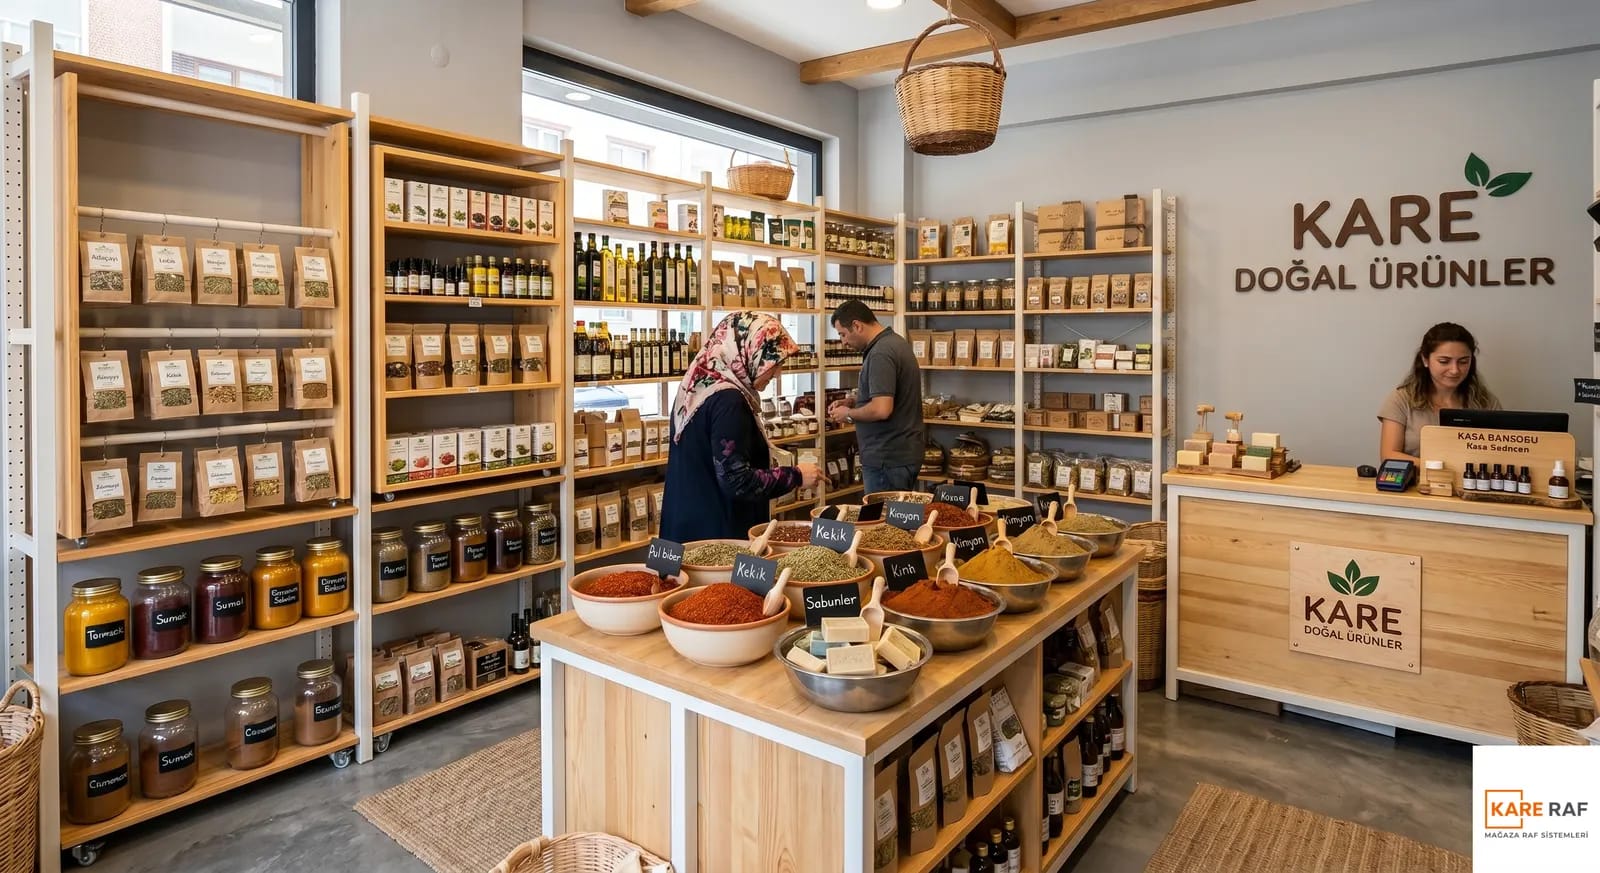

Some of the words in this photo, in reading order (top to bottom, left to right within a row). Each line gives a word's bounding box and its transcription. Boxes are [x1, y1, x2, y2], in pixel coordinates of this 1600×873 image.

[1293, 189, 1480, 251] KARE
[1235, 259, 1357, 292] DOĞAL
[1369, 254, 1555, 290] ÜRÜNLER
[1457, 432, 1485, 441] KASA
[1466, 442, 1488, 451] Kasa
[815, 525, 847, 542] Kekik
[648, 543, 662, 559] Pul
[662, 546, 682, 562] biber
[736, 562, 767, 582] Kekik
[806, 591, 857, 610] Sabunler
[1305, 595, 1402, 636] KARE
[1304, 625, 1344, 640] DOĞAL
[1347, 630, 1403, 650] ÜRÜNLER
